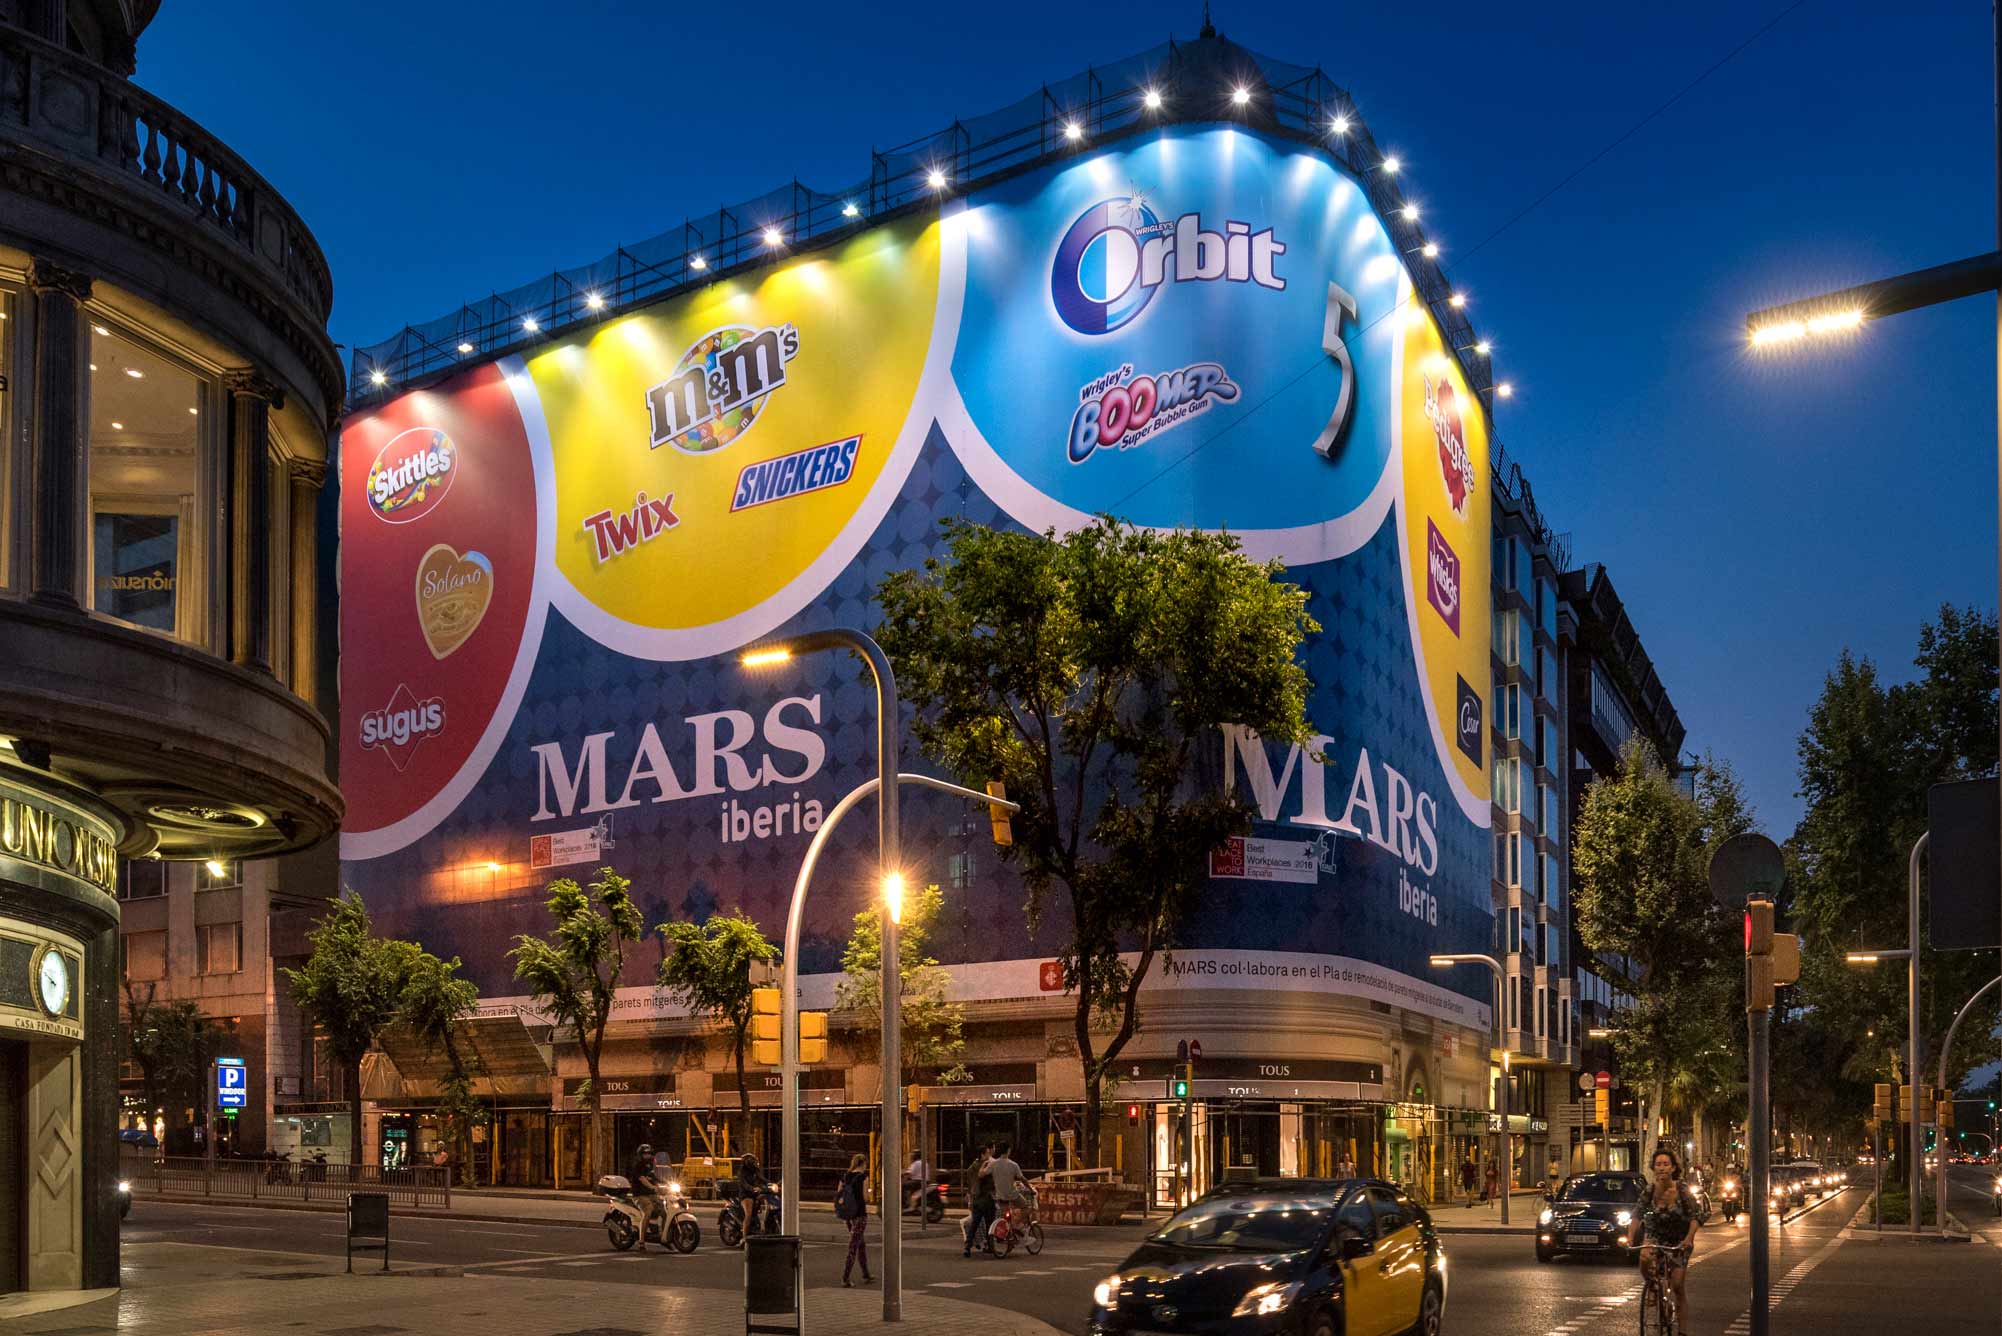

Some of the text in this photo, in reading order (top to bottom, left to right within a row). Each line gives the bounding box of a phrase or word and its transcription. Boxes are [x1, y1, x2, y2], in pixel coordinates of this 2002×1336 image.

[1135, 221, 1174, 236] WRIGLEY'S
[1051, 196, 1287, 335] Orbit
[1082, 365, 1131, 400] Wrigley's
[1312, 280, 1357, 458] 5
[1069, 364, 1237, 462] BOOMER
[1121, 400, 1208, 448] Super Bubble Gum
[1424, 373, 1474, 493] Pedigree
[374, 448, 451, 503] Skittles
[735, 439, 858, 508] SNICKERS
[584, 493, 679, 560] Twix
[424, 565, 481, 599] Solano
[363, 704, 441, 746] sugus
[530, 694, 826, 821] MARS
[721, 791, 823, 843] iberia
[1218, 723, 1438, 877] MARS
[1217, 865, 1242, 875] WORK
[1247, 856, 1292, 868] Workplaces
[1400, 868, 1438, 927] iberia
[1174, 960, 1217, 975] MARS
[1221, 961, 1288, 977] col·labora
[1291, 966, 1306, 977] en
[1310, 964, 1321, 978] el
[1323, 965, 1340, 980] Pla
[1342, 968, 1353, 982] de
[612, 995, 684, 1012] parets mitgeres
[225, 1068, 239, 1088] P
[607, 1082, 629, 1091] TOUS
[764, 1076, 784, 1087] TOU
[1259, 1065, 1290, 1076] TOUS
